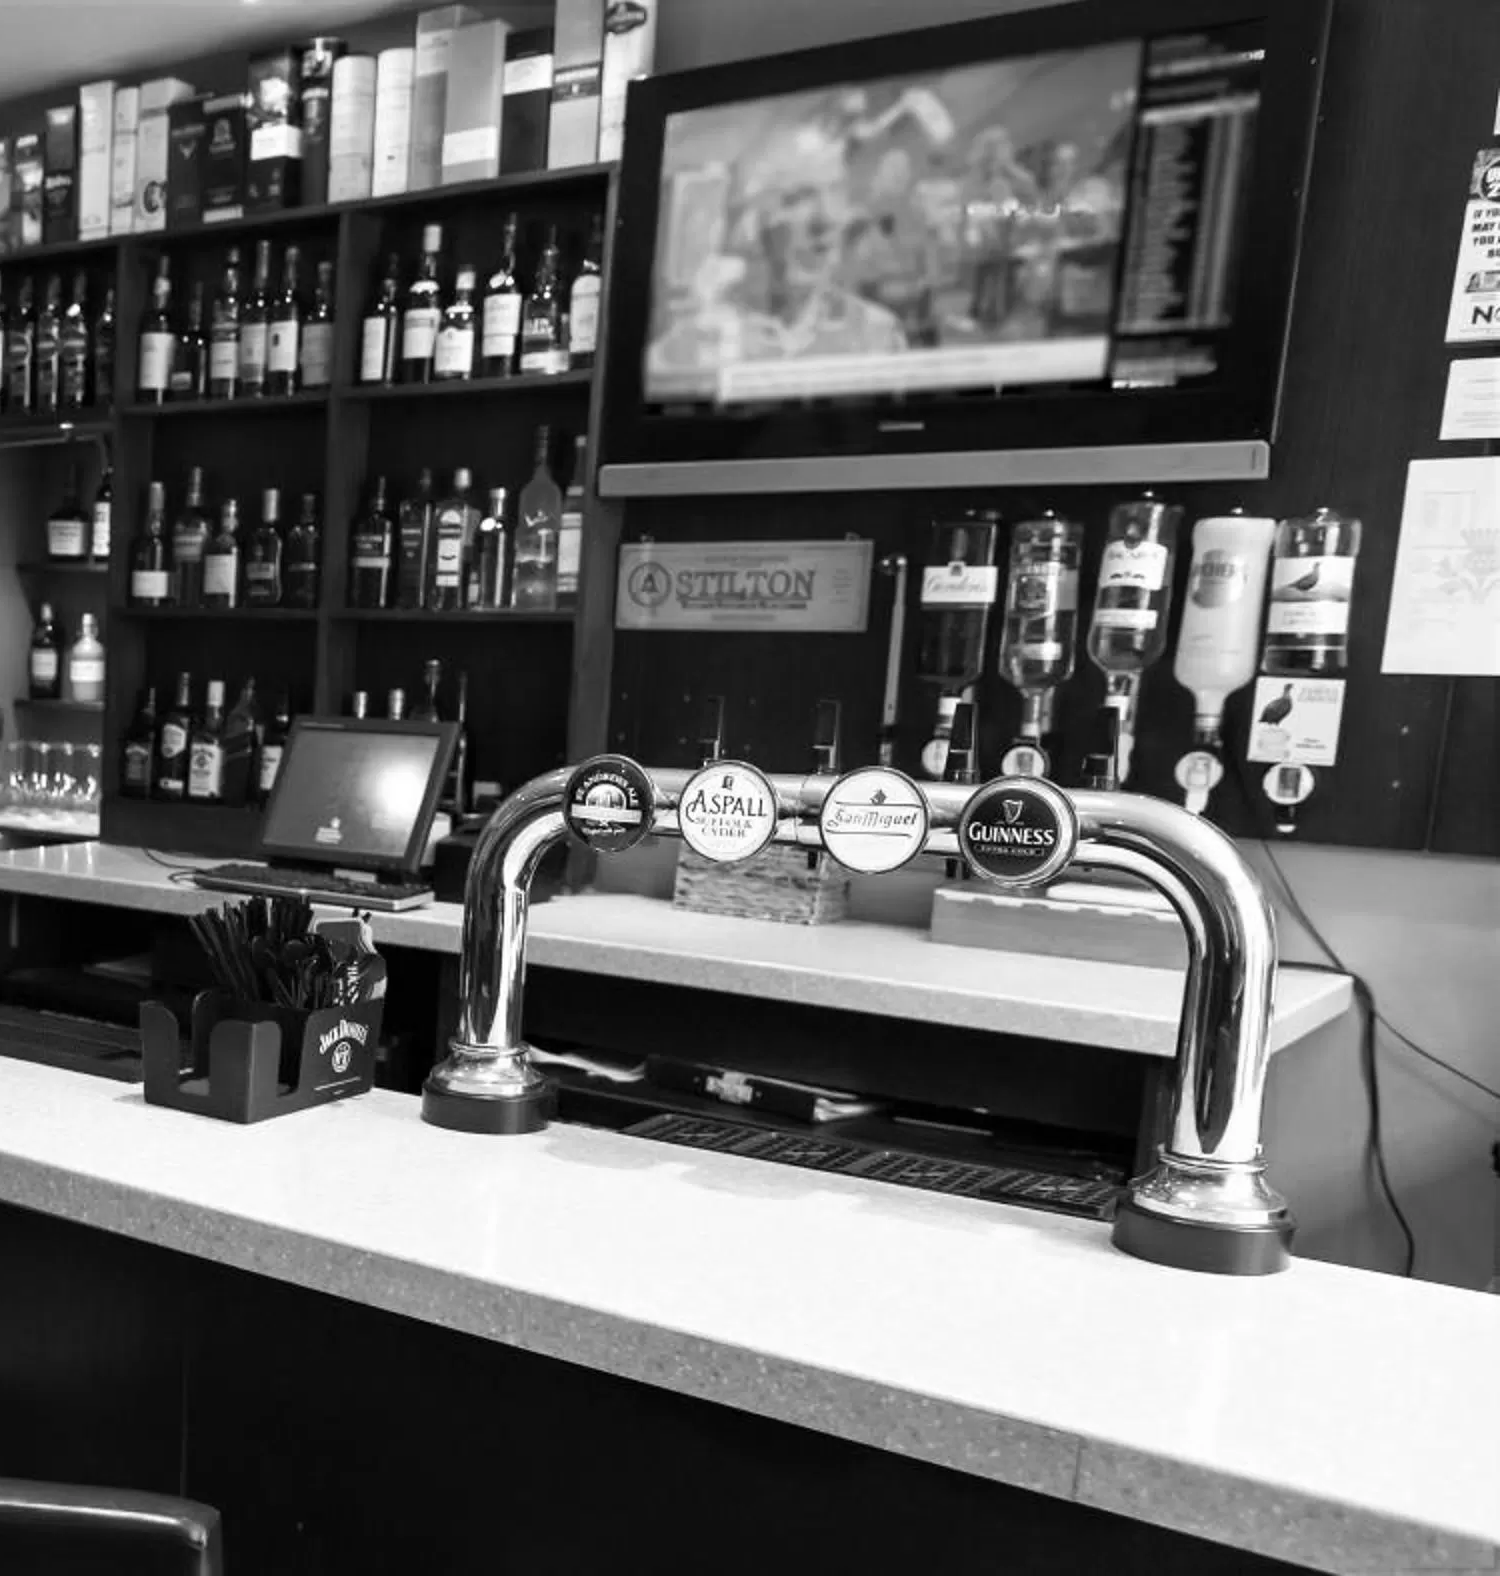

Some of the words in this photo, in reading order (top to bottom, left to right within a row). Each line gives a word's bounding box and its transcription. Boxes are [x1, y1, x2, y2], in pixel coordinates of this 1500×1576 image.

[674, 569, 816, 601] STILTON
[685, 790, 768, 823] ASPALL
[968, 821, 1056, 846] GUINNESS
